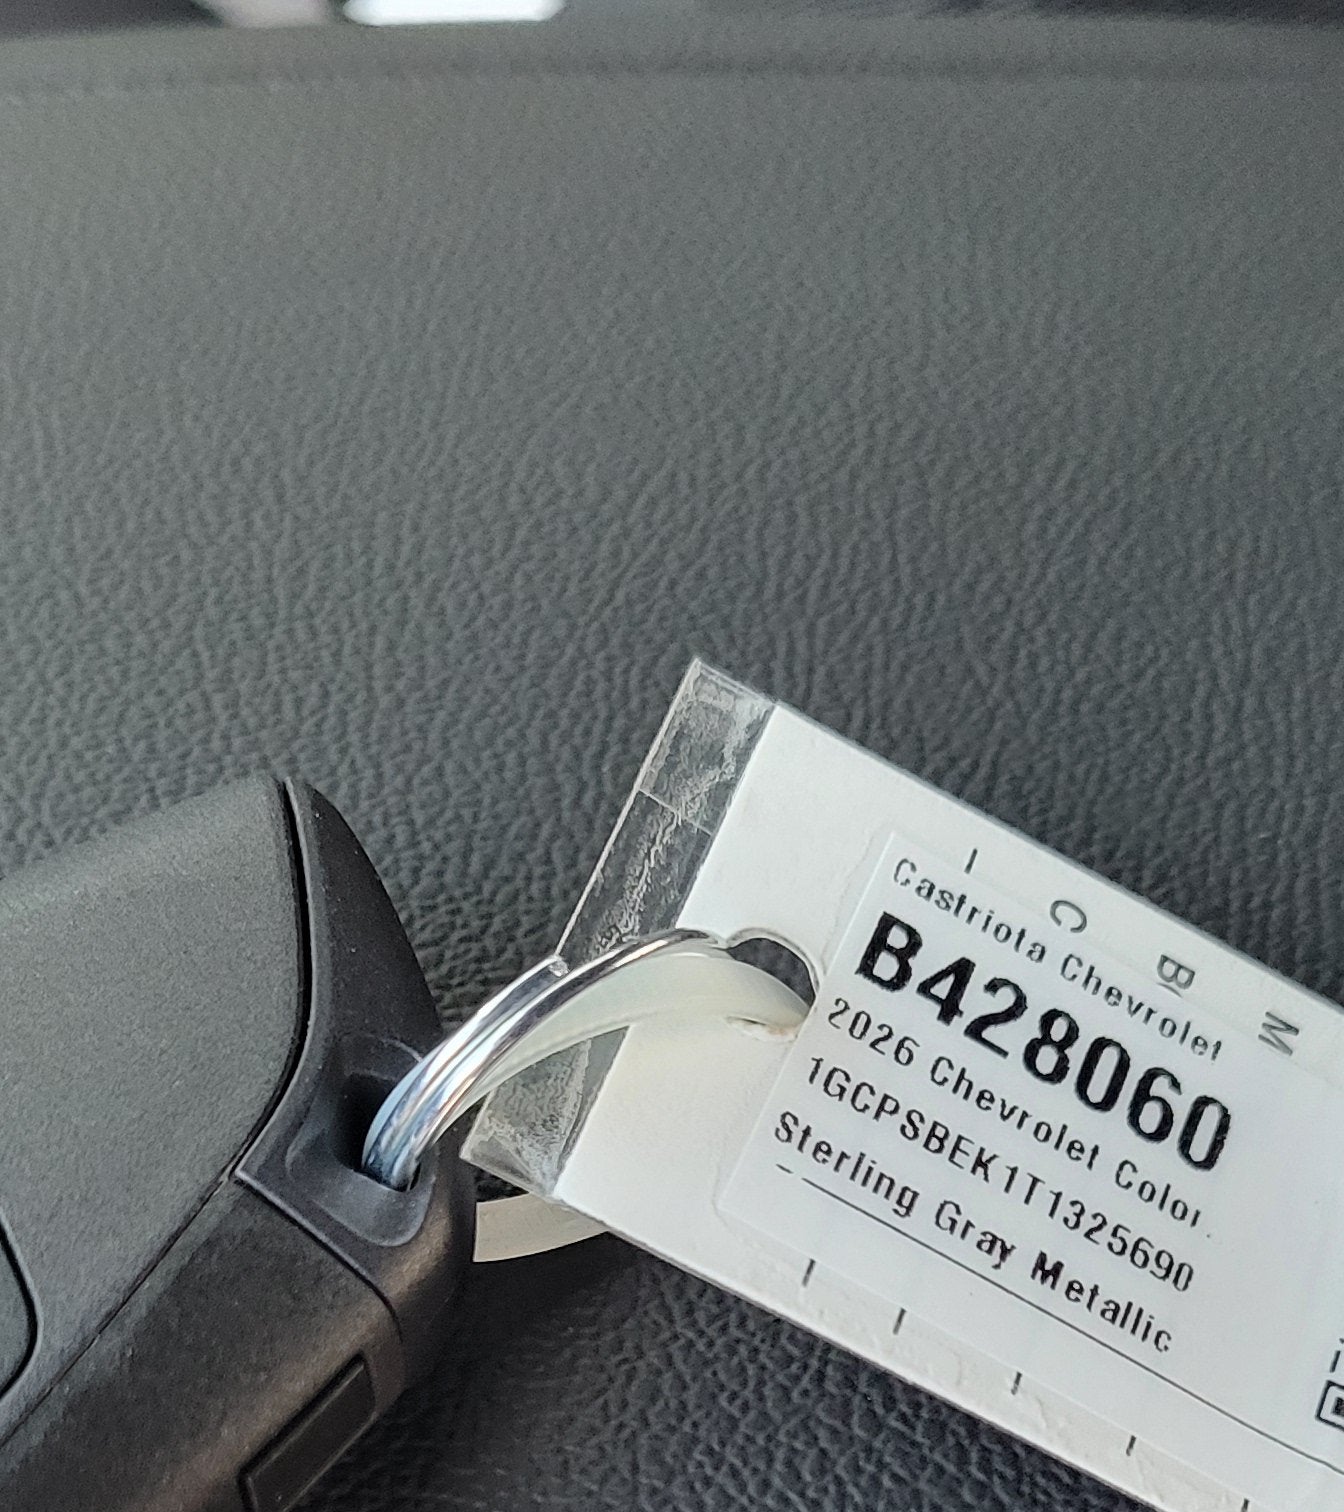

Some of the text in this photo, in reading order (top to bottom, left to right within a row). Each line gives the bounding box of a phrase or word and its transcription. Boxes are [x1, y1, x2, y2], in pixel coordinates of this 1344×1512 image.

[855, 911, 1232, 1172] B428060
[893, 857, 1223, 1061] Castriota Chevrolet
[808, 1056, 1194, 1292] 1GCPSBEK1T1325690
[827, 997, 918, 1067] 2026
[930, 1056, 1100, 1170] Chevrolet
[775, 1110, 1173, 1353] Sterling Gray Metallic
